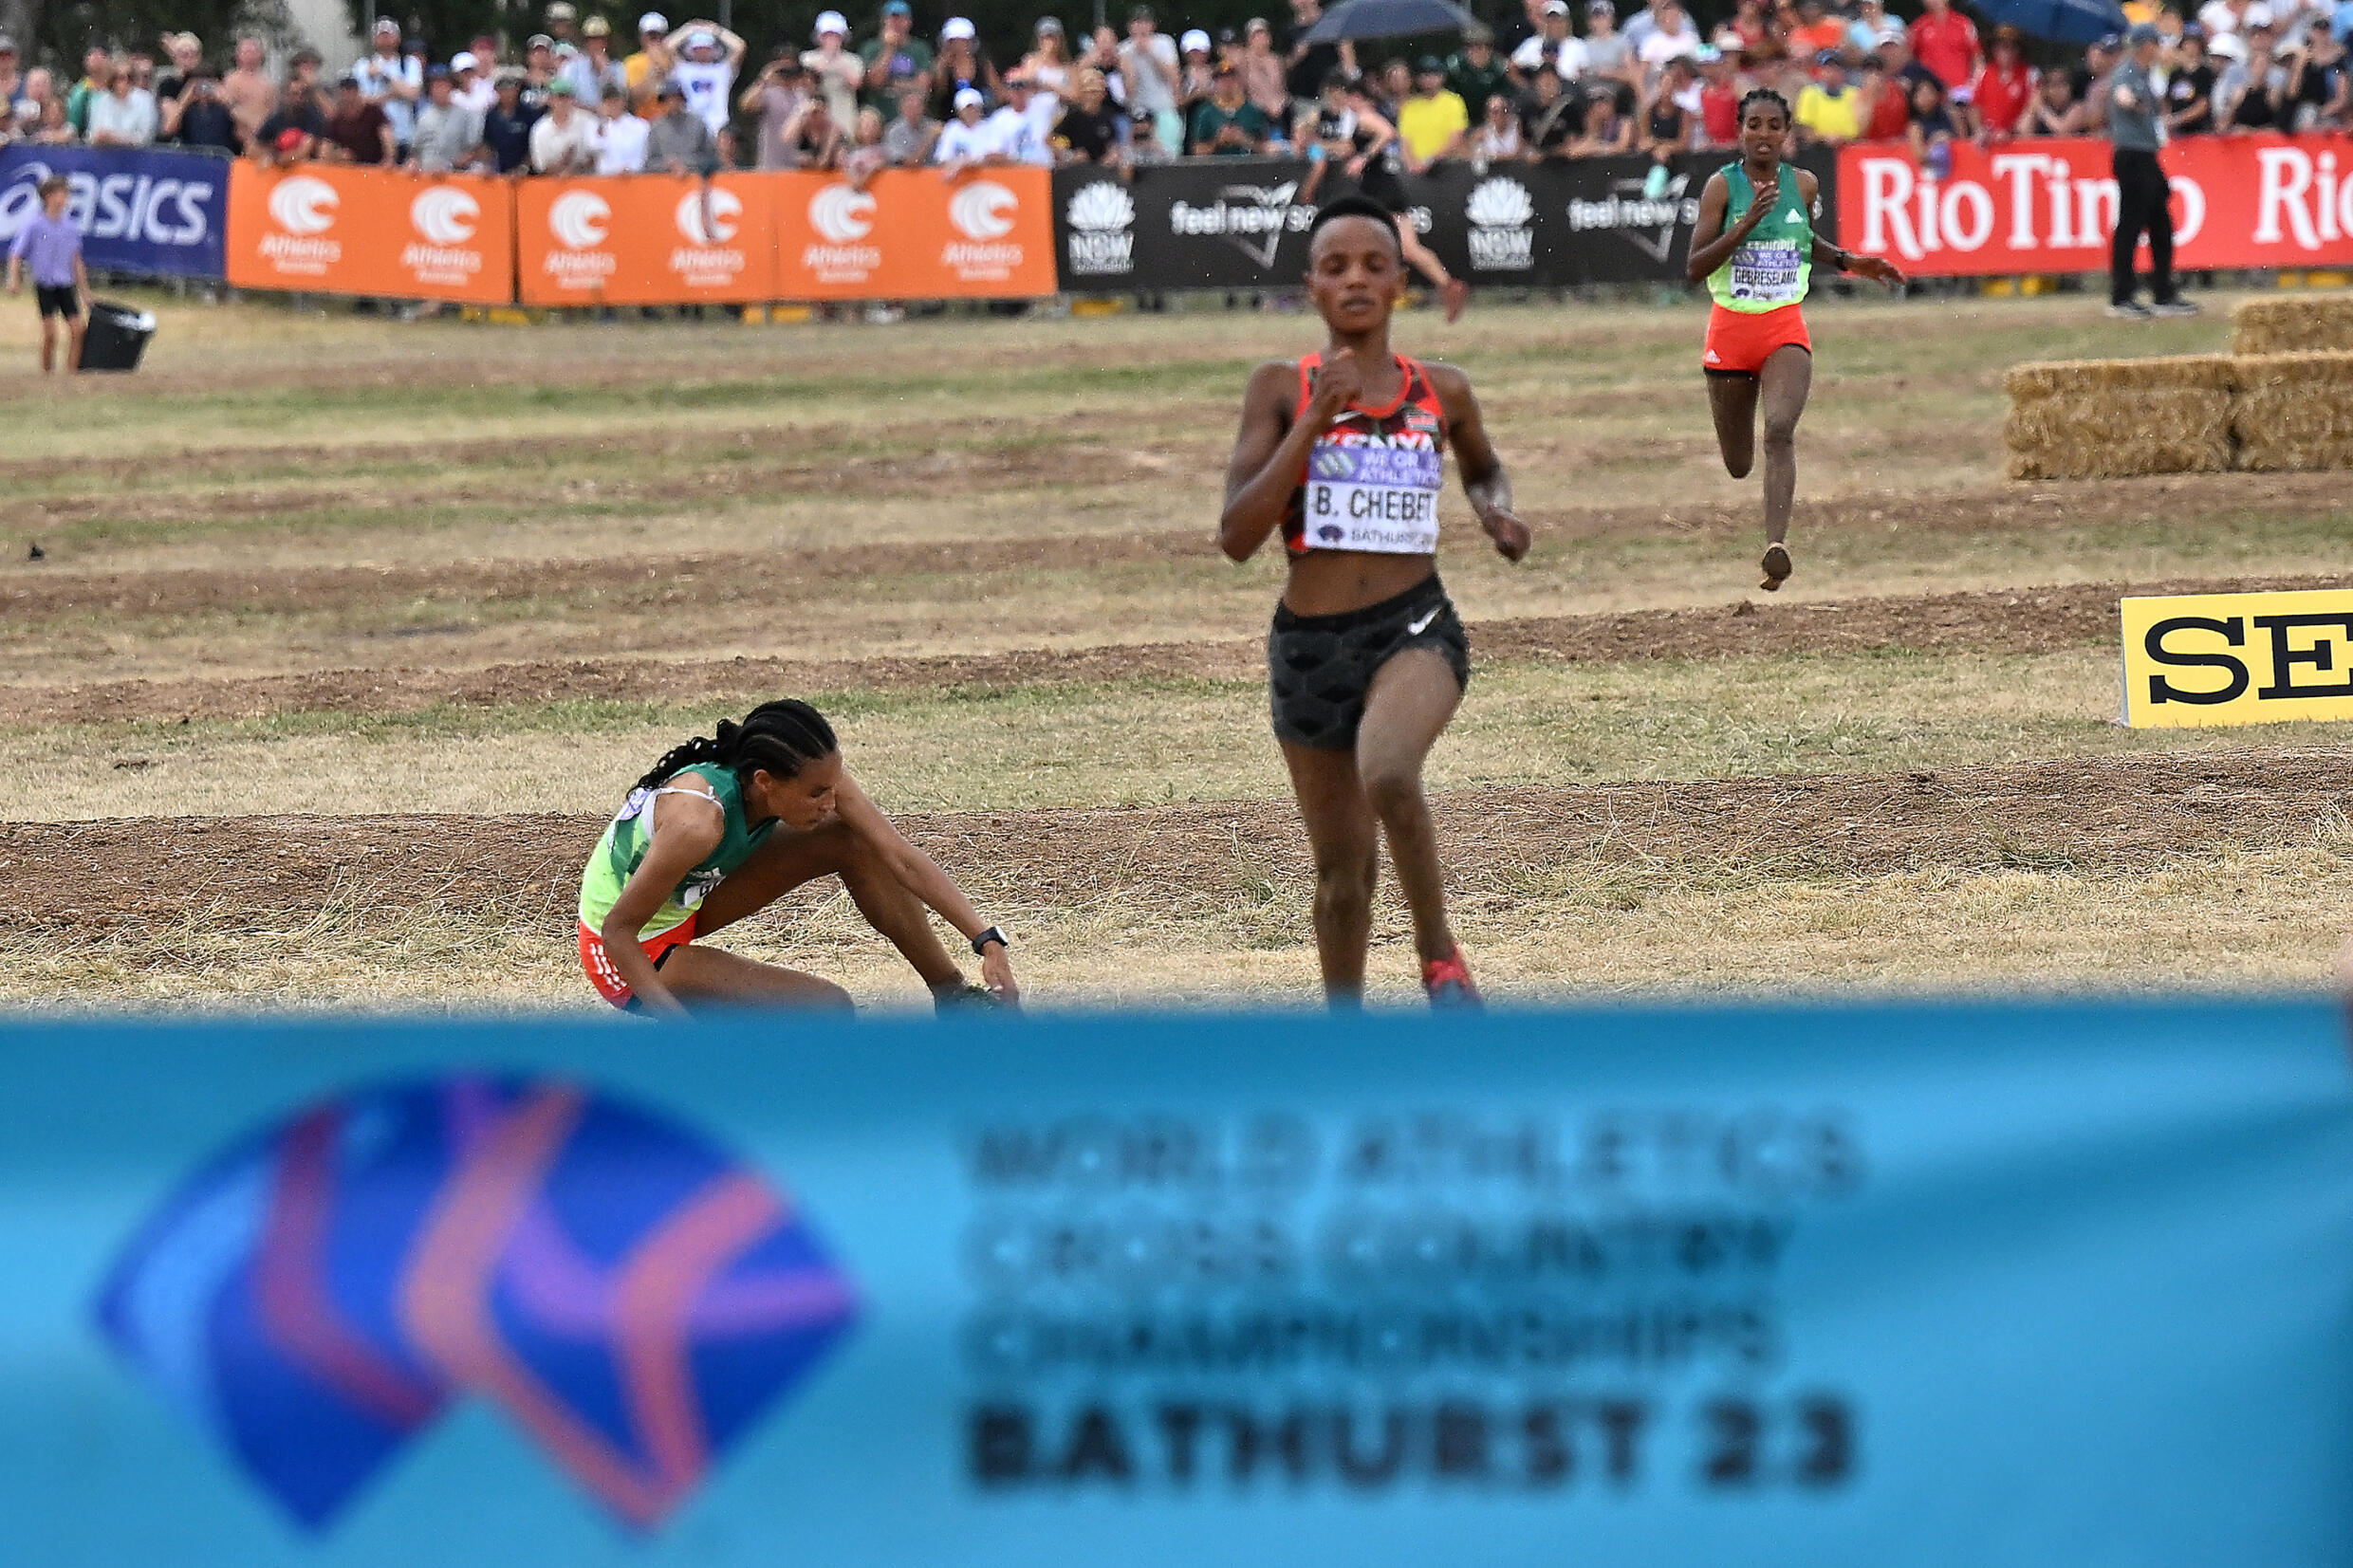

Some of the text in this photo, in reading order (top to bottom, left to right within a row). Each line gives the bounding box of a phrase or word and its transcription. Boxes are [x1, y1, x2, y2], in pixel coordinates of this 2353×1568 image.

[1171, 200, 1227, 235] feel
[1228, 206, 1285, 234] new
[1567, 194, 1619, 231] feel
[1860, 152, 2206, 260] Rio Tino
[2252, 145, 2353, 249] Ri
[1316, 486, 1340, 517] B.
[2144, 613, 2353, 705] SE
[970, 1399, 1648, 1492] BATHURST
